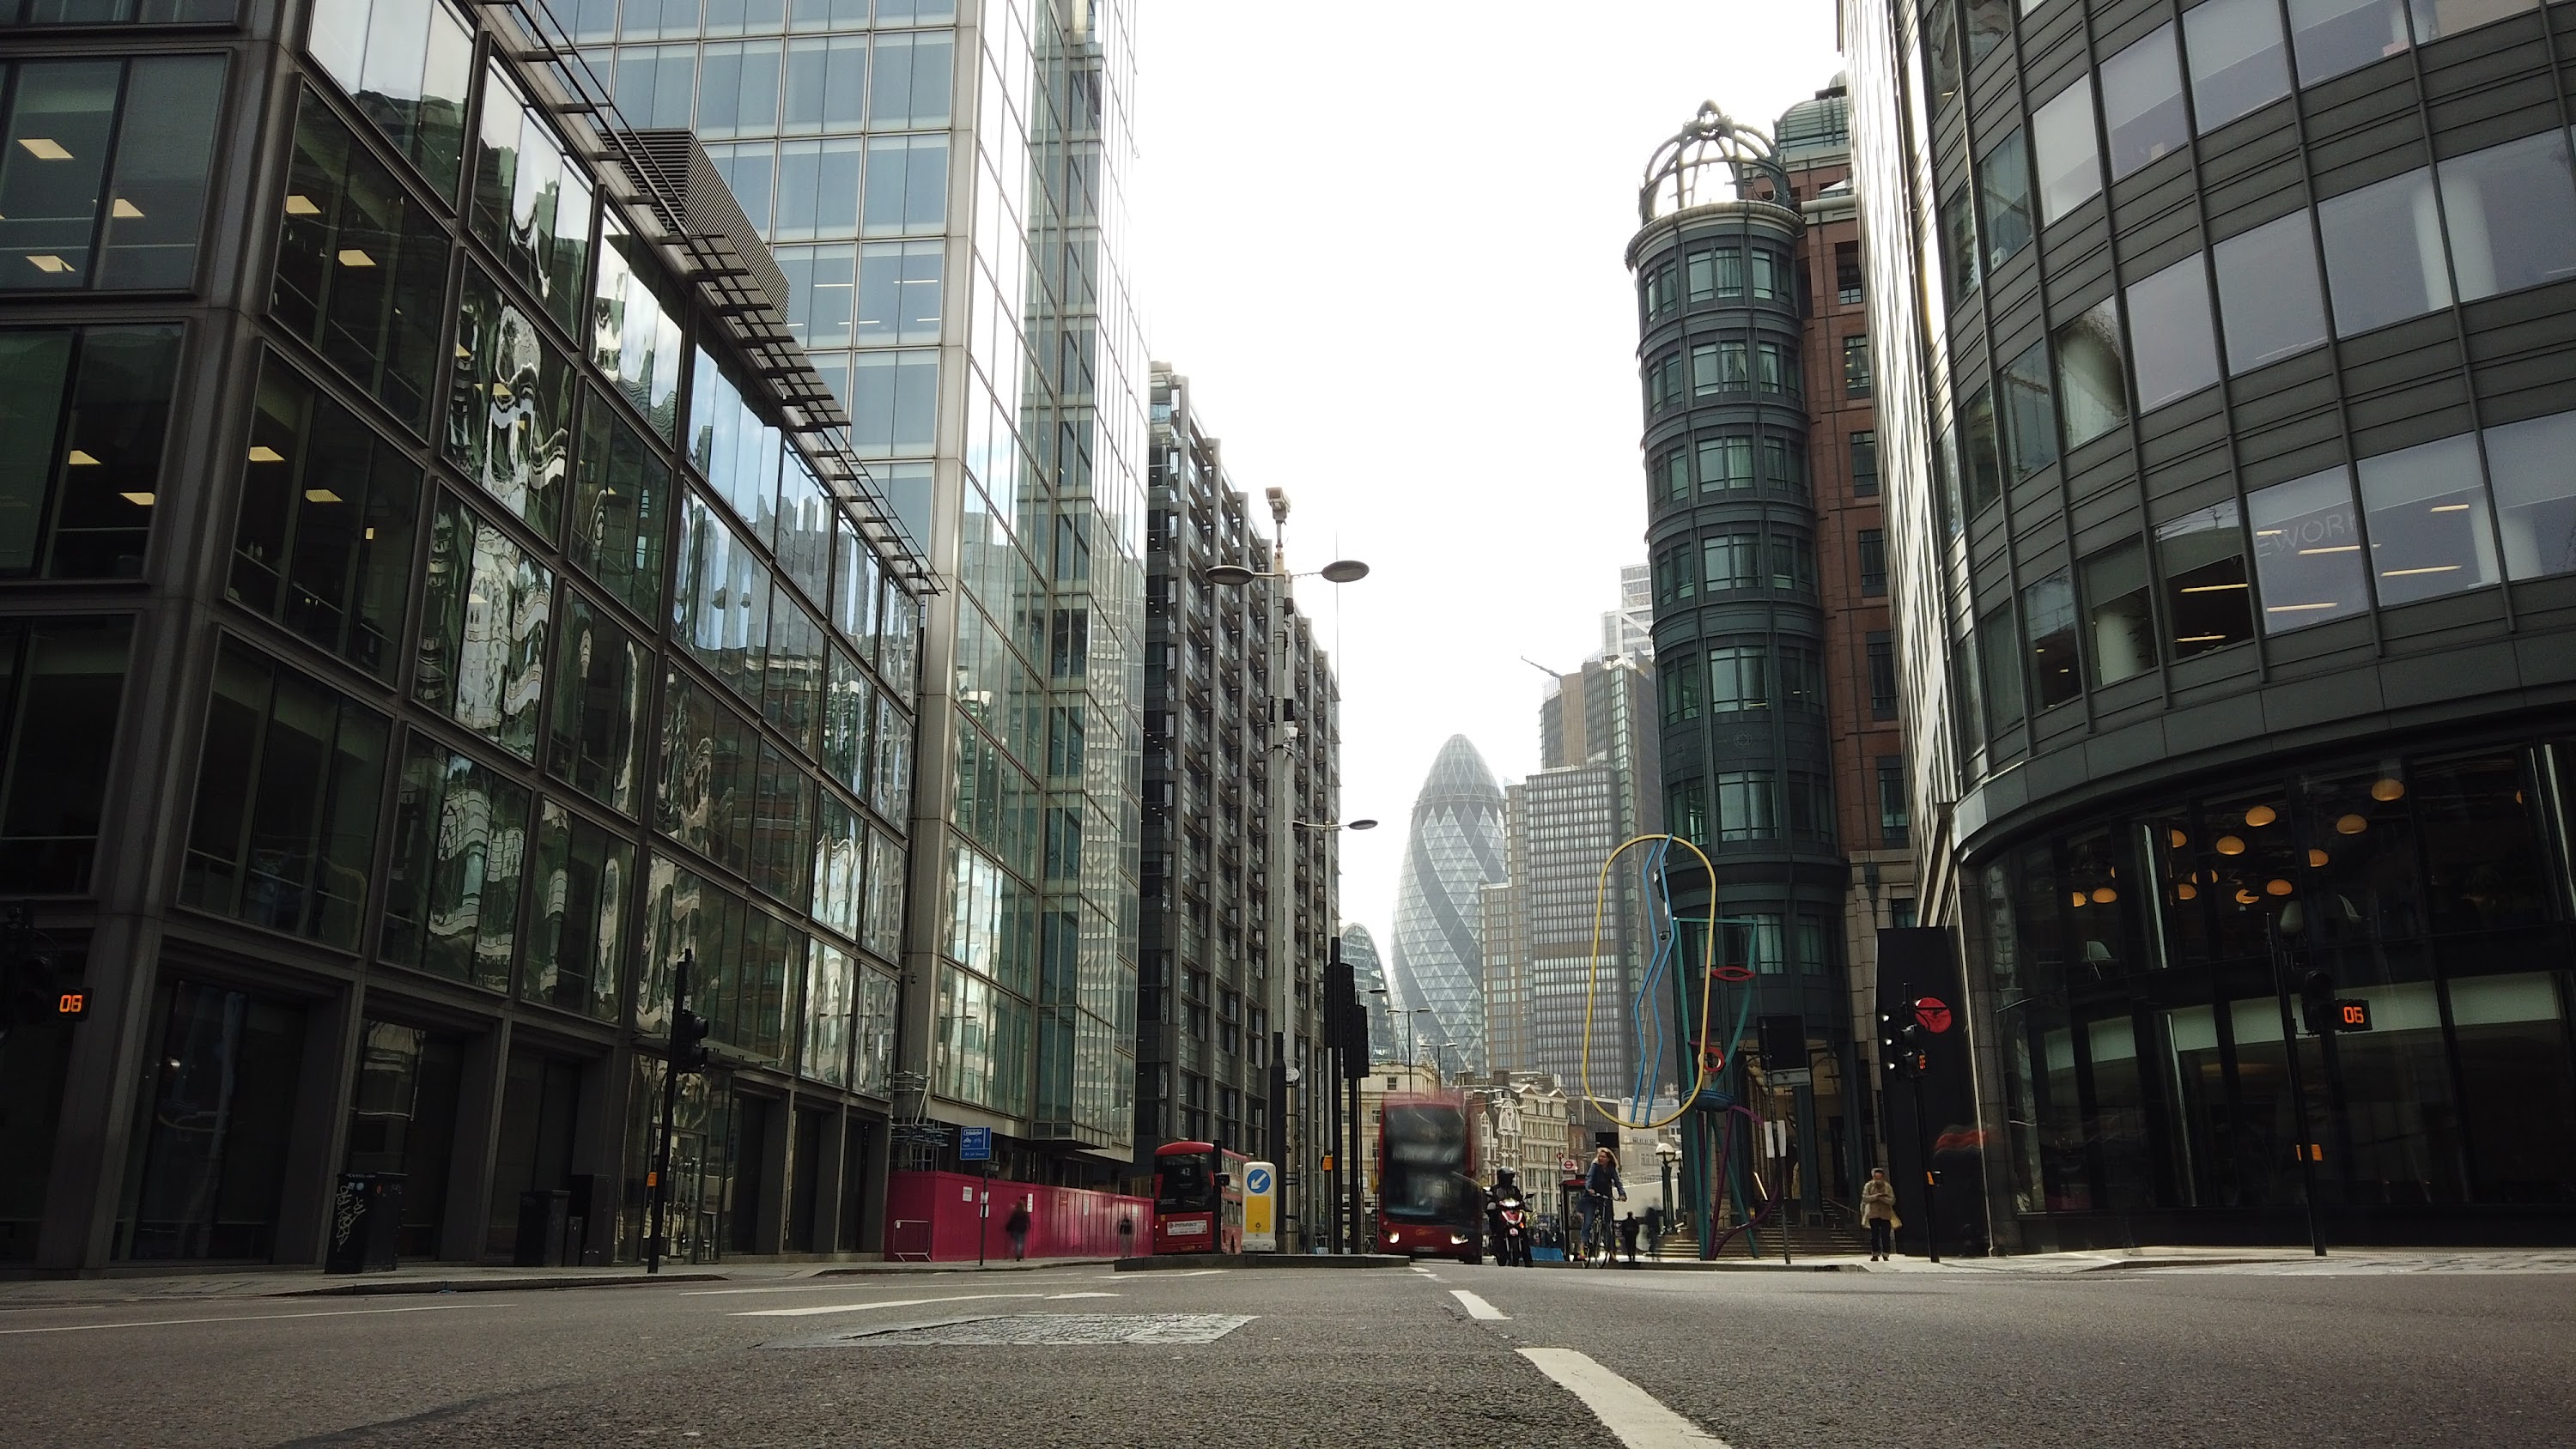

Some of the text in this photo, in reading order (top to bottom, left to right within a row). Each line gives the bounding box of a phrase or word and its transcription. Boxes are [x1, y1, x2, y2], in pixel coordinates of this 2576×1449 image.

[59, 995, 83, 1013] 06
[2343, 1006, 2365, 1024] 06
[1181, 1167, 1191, 1176] 42
